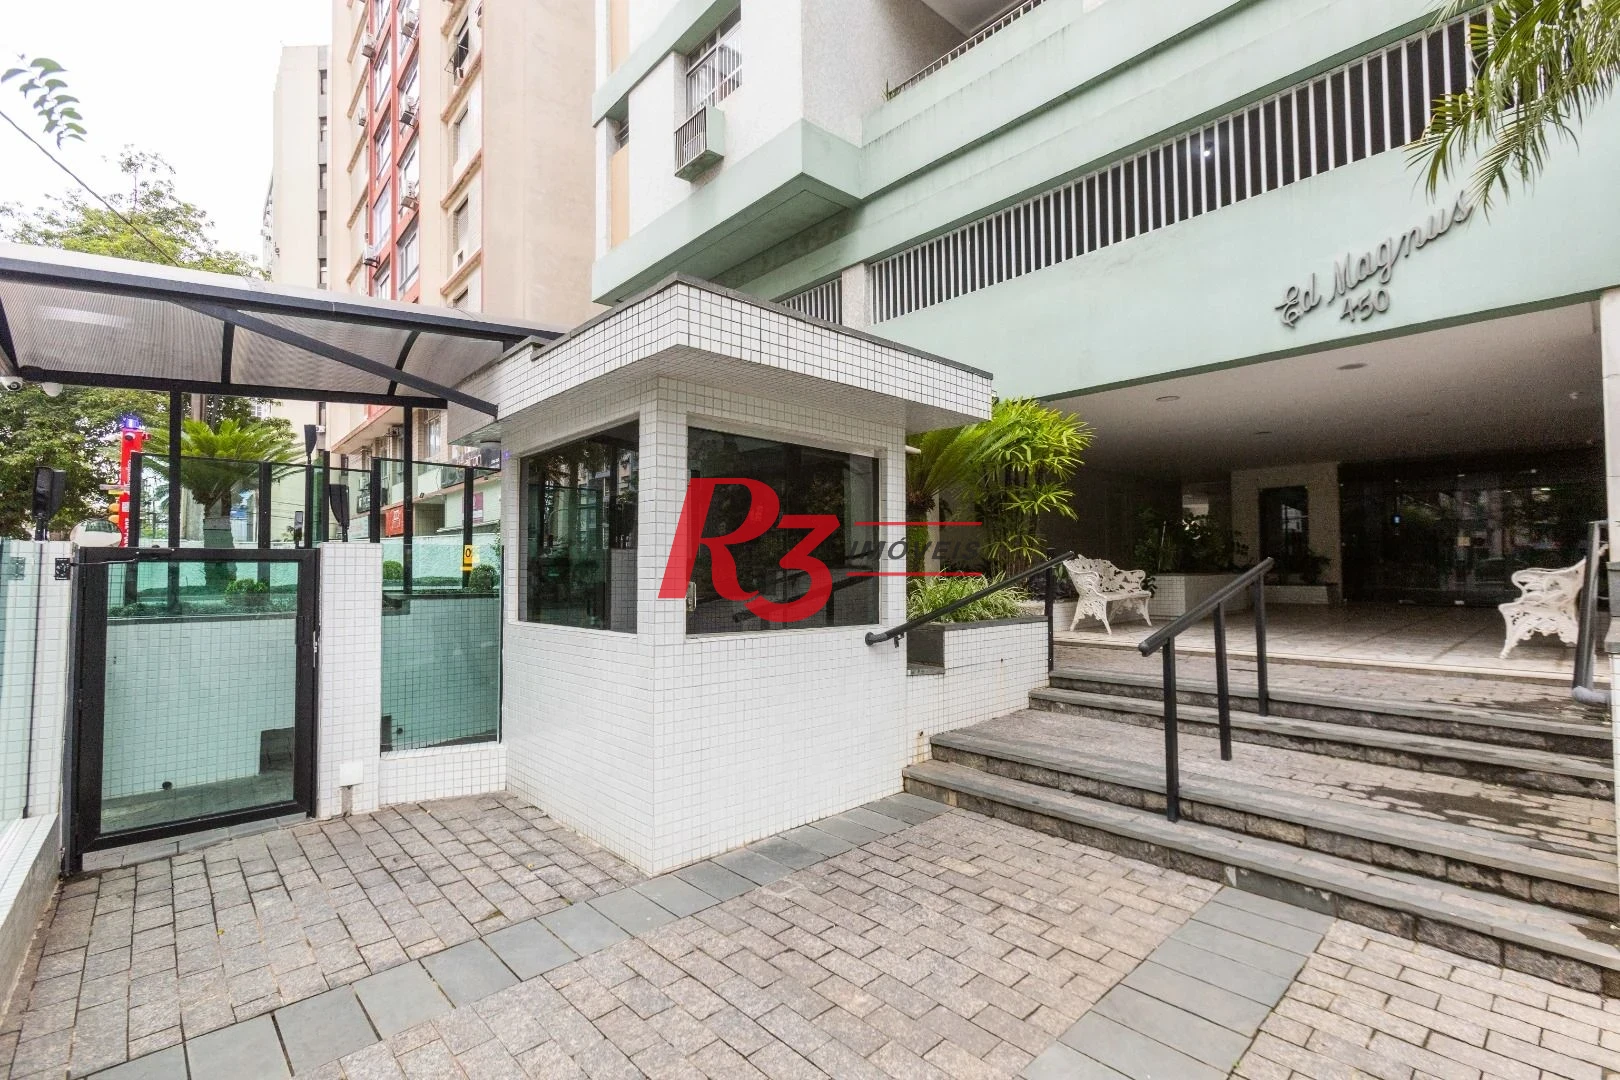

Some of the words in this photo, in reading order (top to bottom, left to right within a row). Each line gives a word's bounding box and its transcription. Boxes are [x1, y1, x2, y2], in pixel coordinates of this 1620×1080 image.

[1275, 272, 1322, 328] Ed
[1328, 190, 1473, 305] Magnus
[1340, 288, 1391, 322] 450
